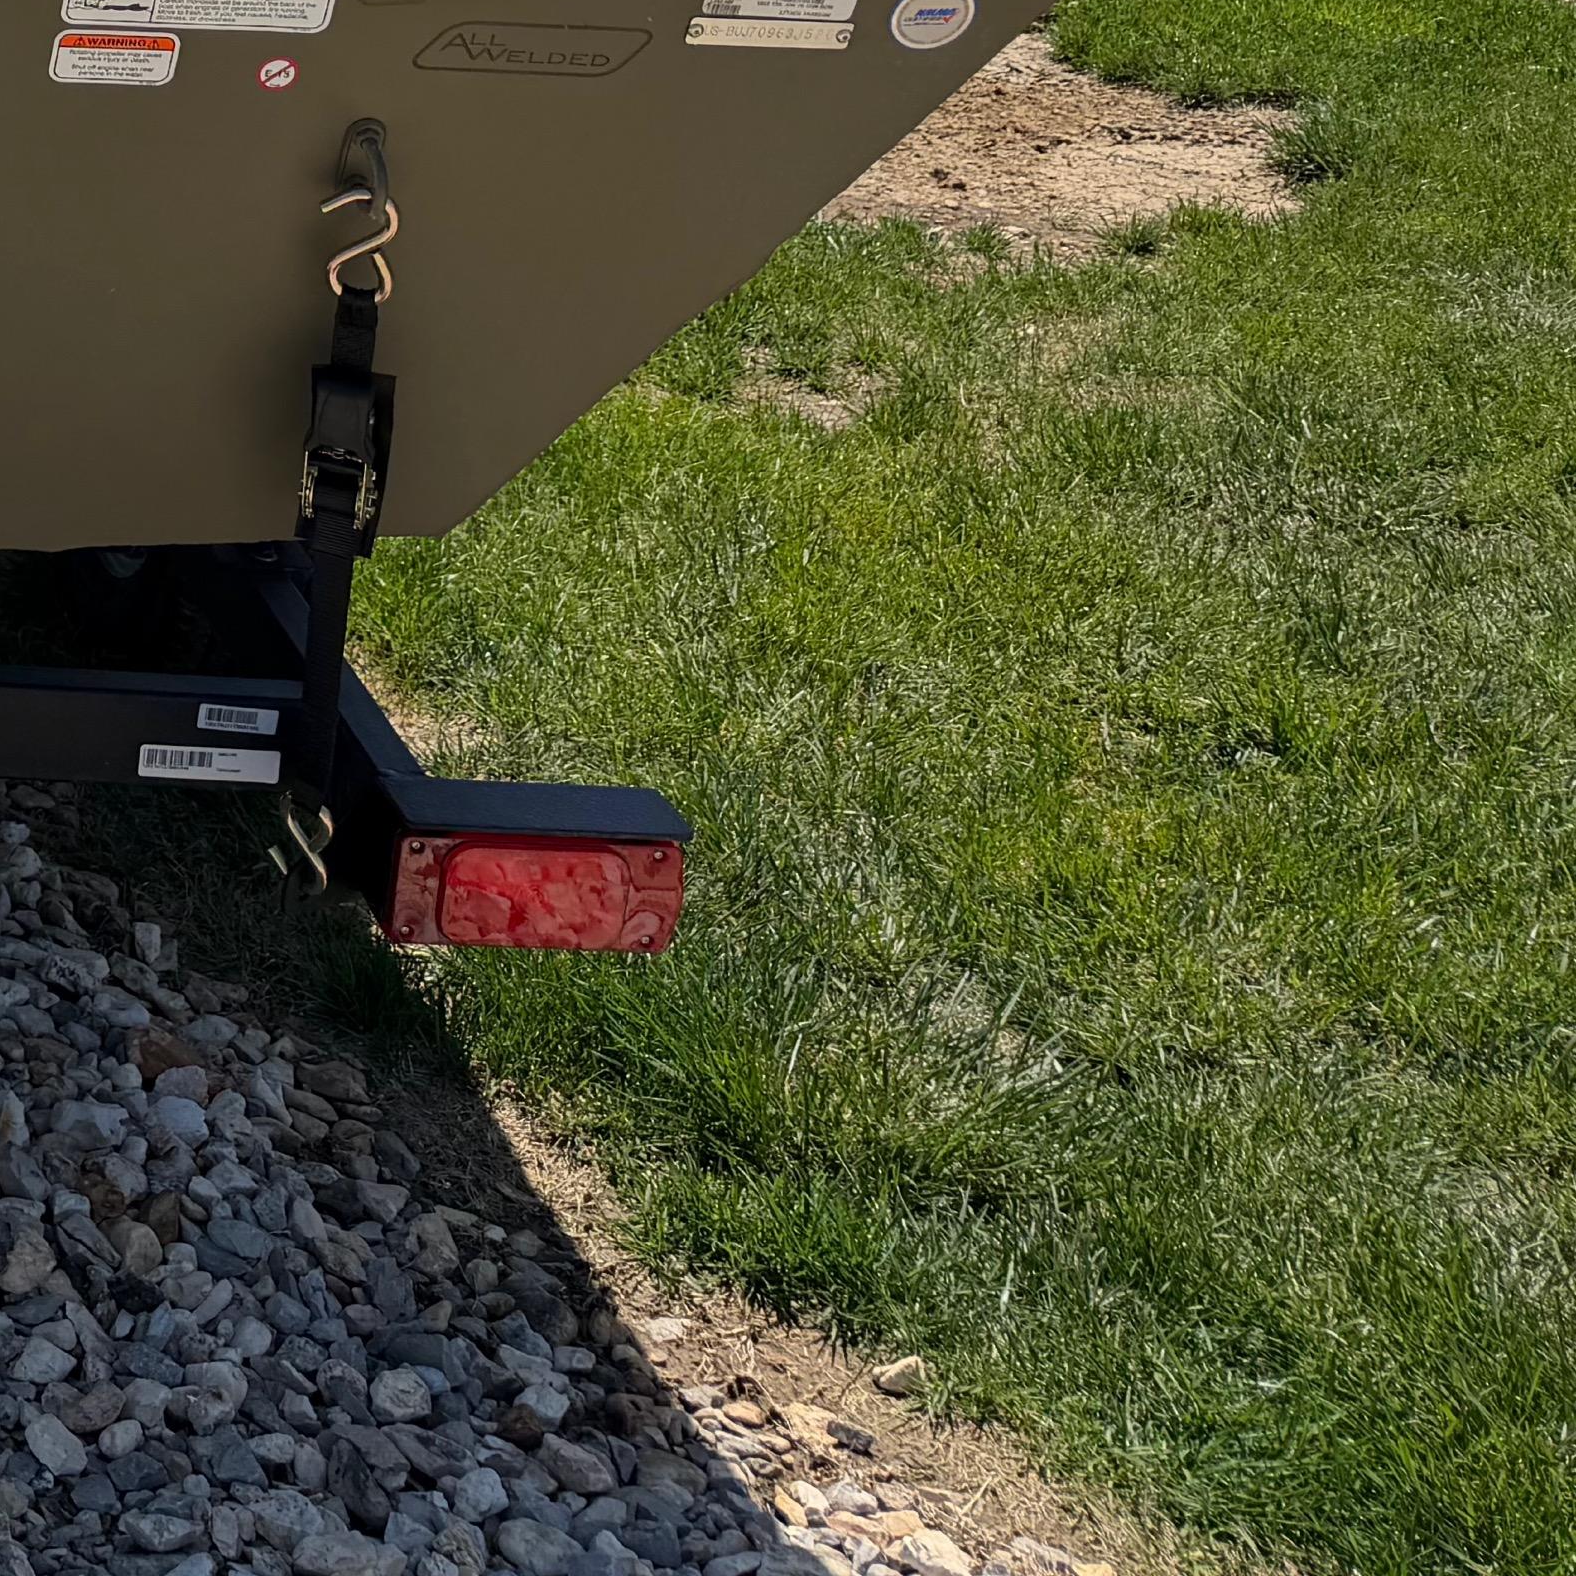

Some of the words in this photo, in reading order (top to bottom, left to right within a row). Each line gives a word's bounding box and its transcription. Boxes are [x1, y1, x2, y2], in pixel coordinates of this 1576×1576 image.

[87, 37, 147, 48] WARNING
[439, 33, 506, 52] ALL
[466, 47, 610, 67] WELDED
